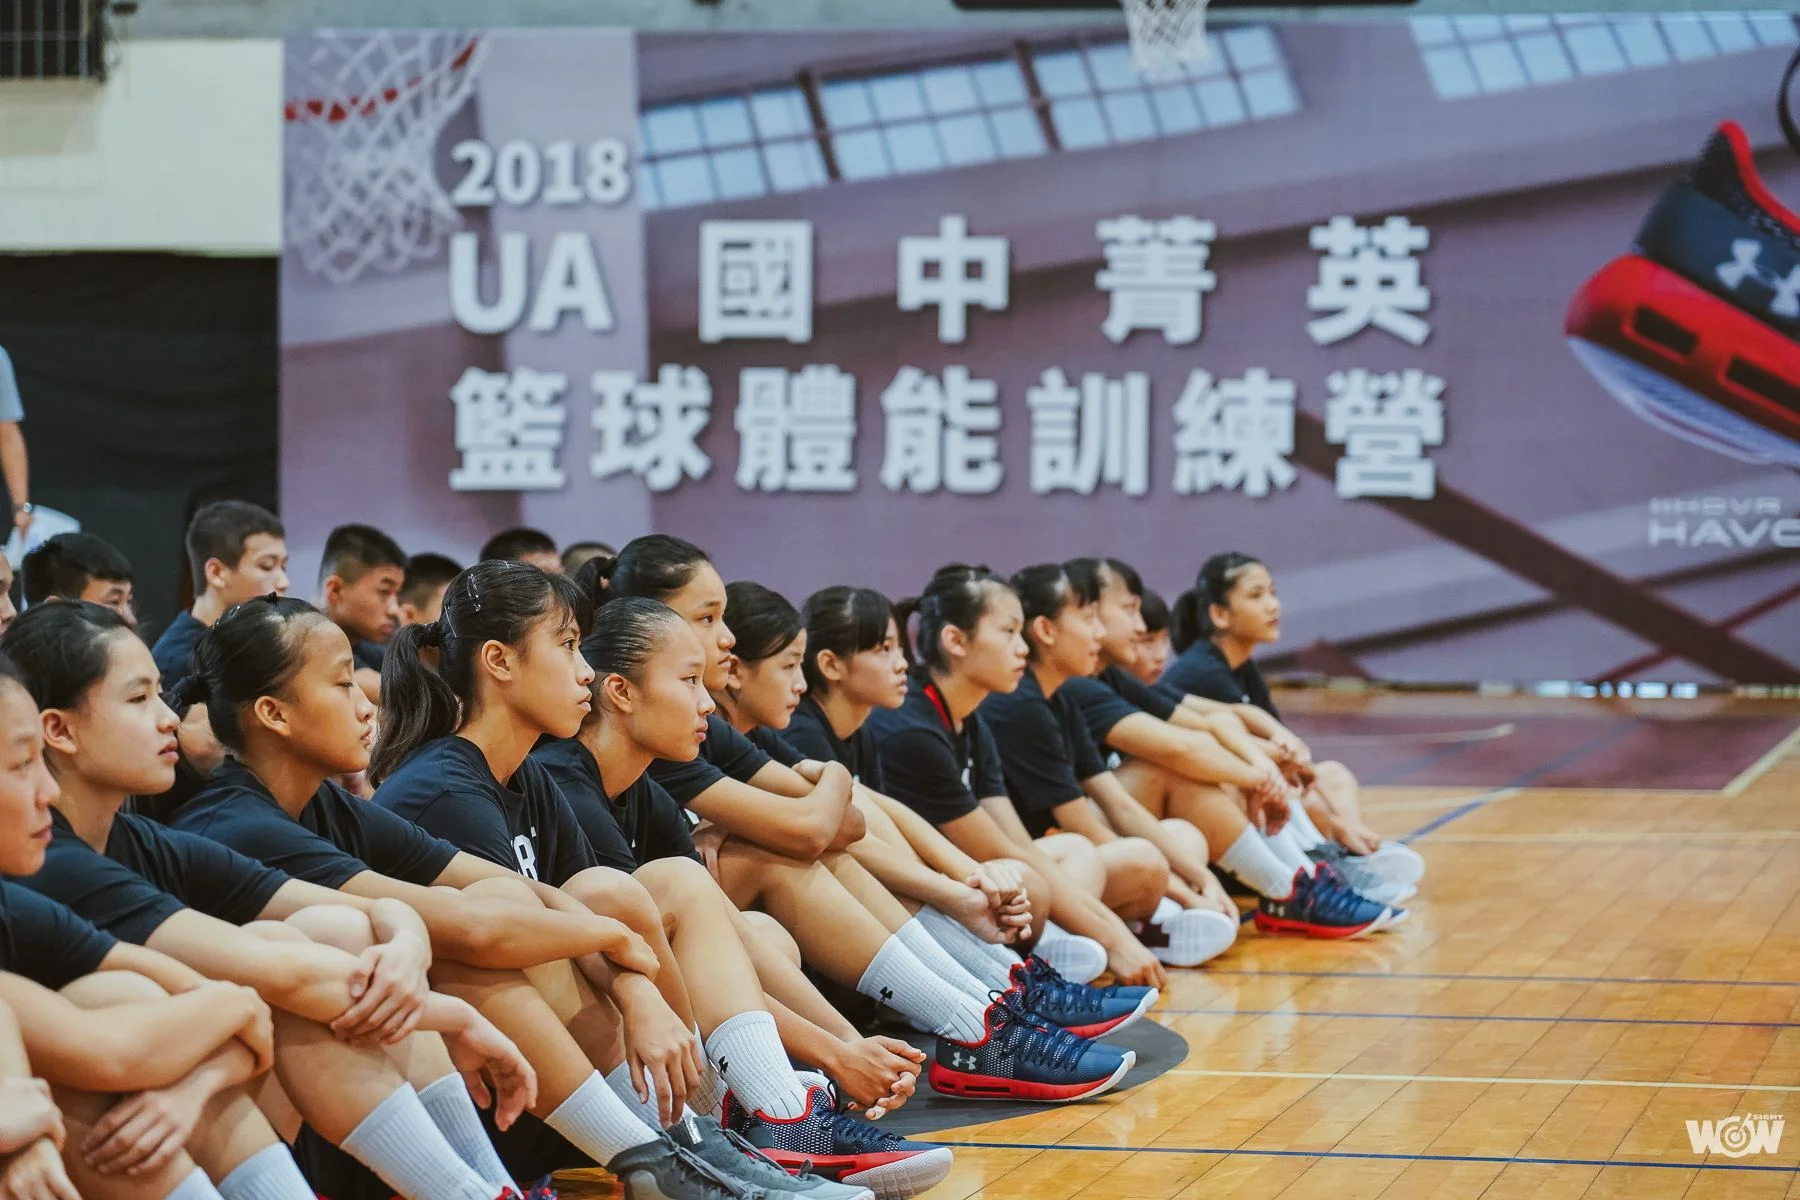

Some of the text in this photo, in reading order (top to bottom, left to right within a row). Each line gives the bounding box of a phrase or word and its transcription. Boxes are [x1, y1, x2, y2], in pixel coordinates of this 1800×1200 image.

[451, 140, 632, 204] 2018
[449, 231, 614, 335] UA
[449, 364, 1446, 499] 籃球體能訓練營
